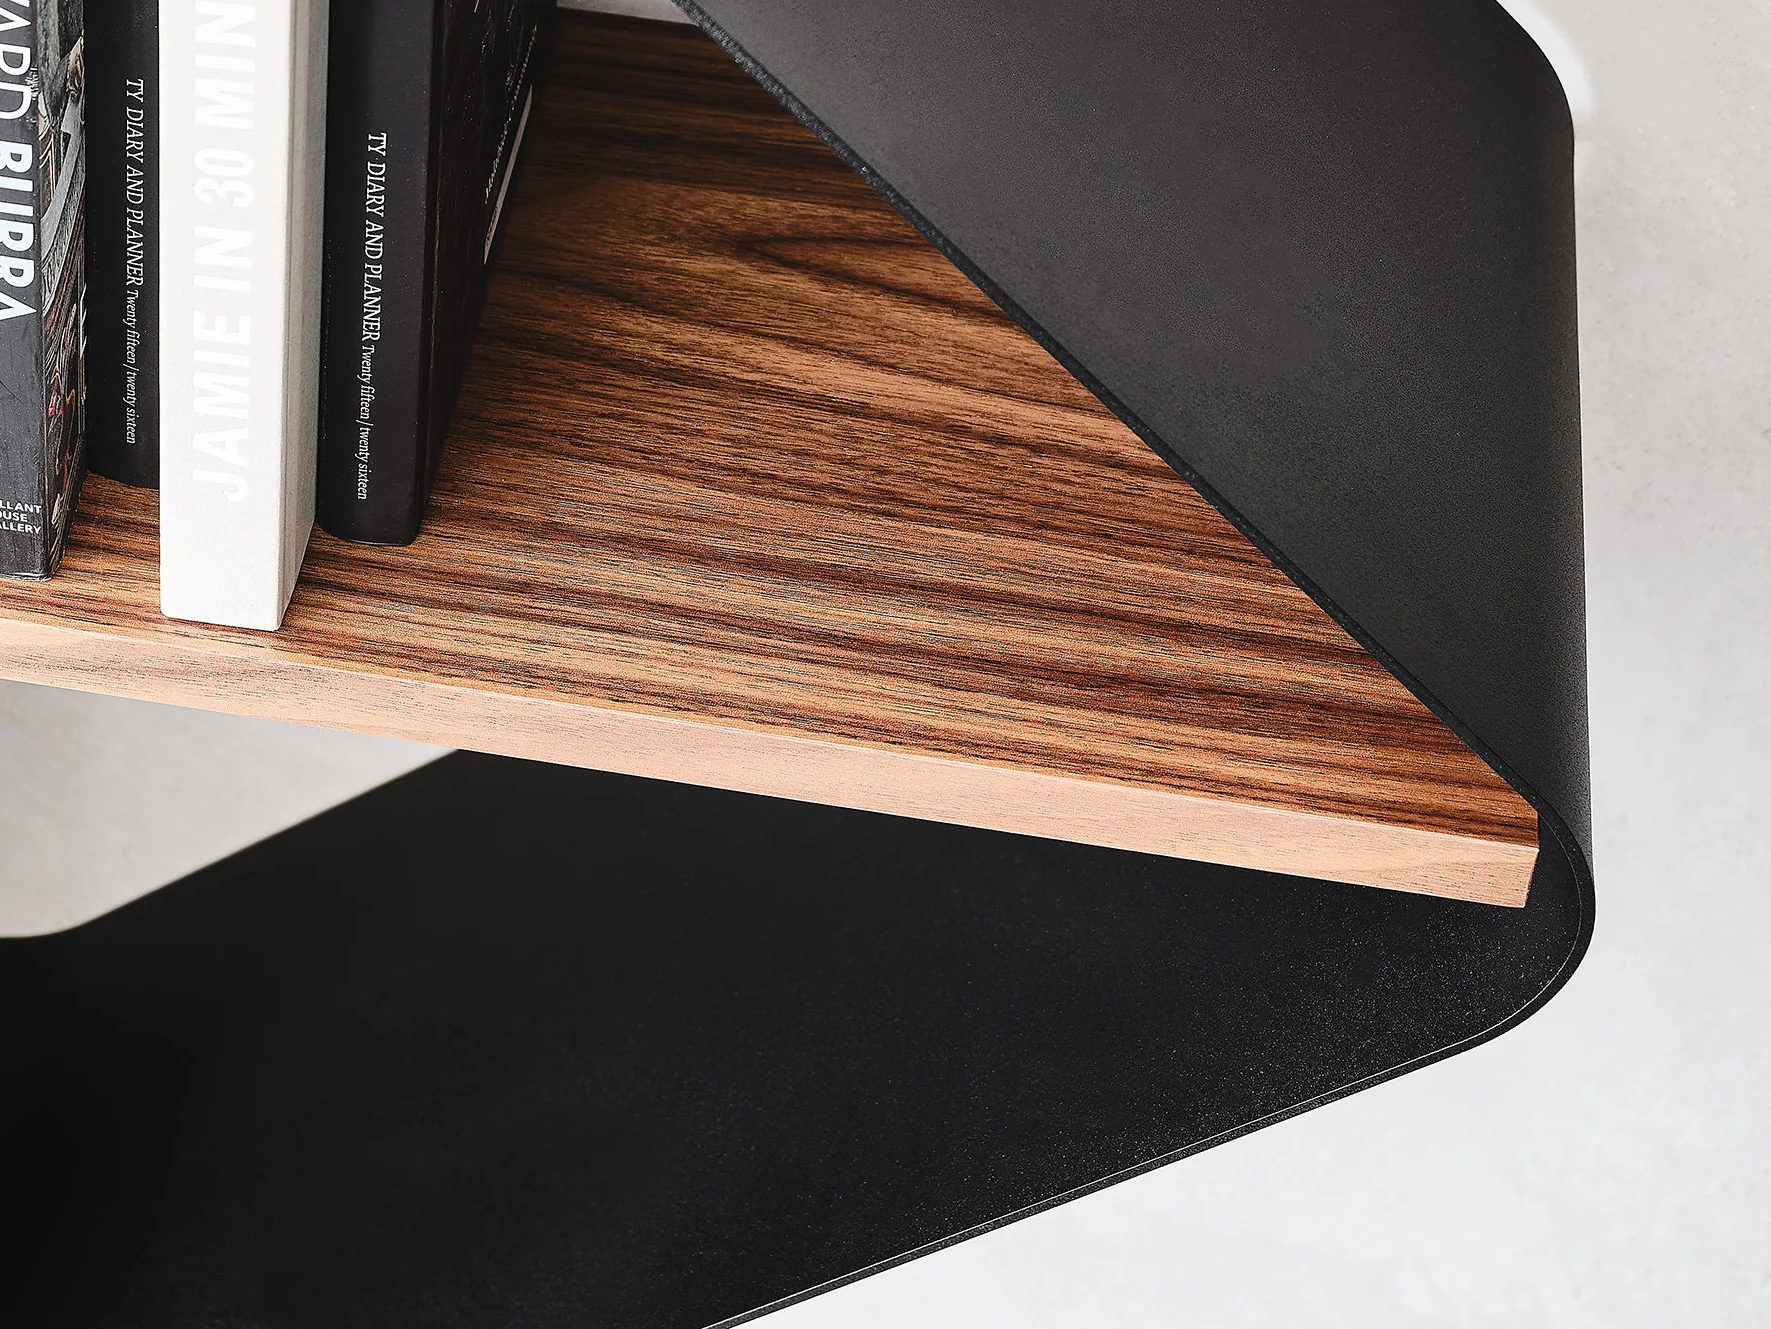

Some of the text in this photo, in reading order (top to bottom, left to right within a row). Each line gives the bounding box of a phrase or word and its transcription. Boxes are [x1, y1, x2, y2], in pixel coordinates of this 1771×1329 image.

[125, 77, 144, 103] TY
[125, 106, 144, 163] DIARY
[367, 132, 387, 157] TY
[125, 164, 144, 205] AND
[193, 145, 255, 207] 30
[365, 161, 387, 218] DIARY
[125, 207, 144, 286] PLANNER
[364, 219, 385, 260] AND
[193, 226, 254, 294] IN
[123, 289, 139, 329] Twenty
[361, 262, 383, 342] PLANNER
[126, 329, 140, 364] fifteen
[357, 344, 375, 384] Twenty
[123, 371, 138, 407] twenty
[192, 309, 251, 503] JAMIE
[359, 384, 375, 419] fifteen
[126, 407, 139, 444] sixteen
[355, 426, 373, 463] twenty
[357, 463, 372, 500] sixteen
